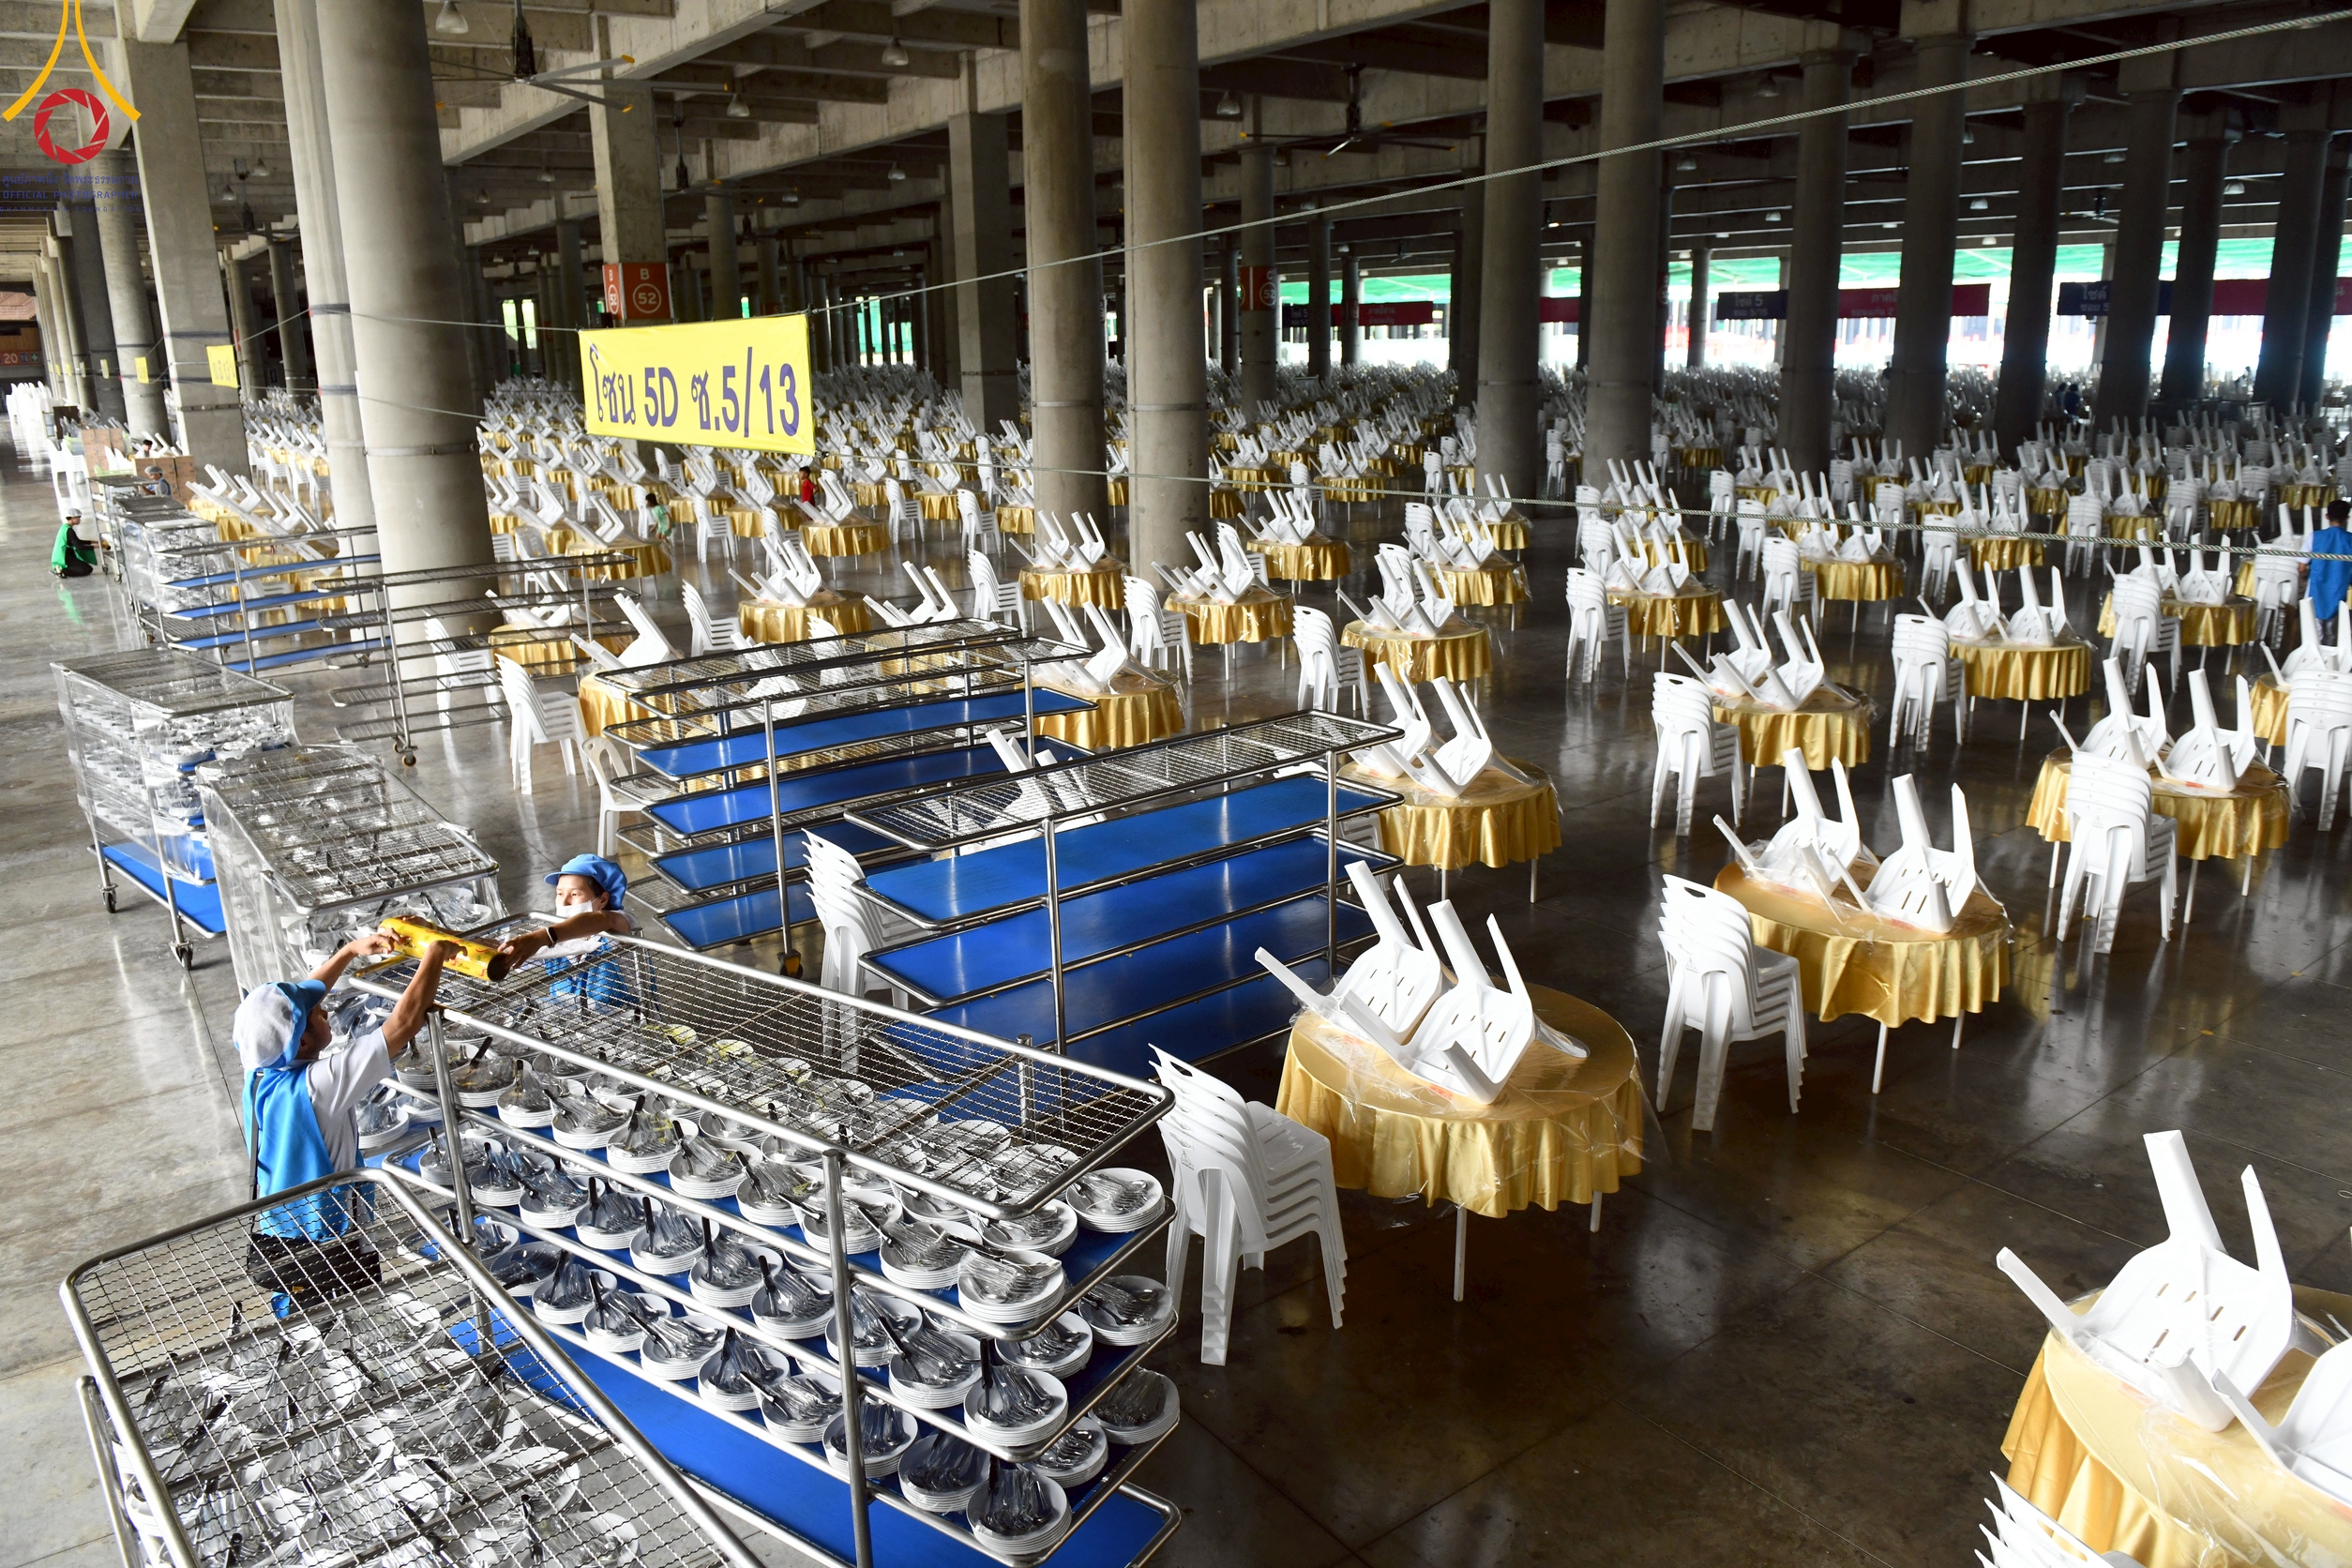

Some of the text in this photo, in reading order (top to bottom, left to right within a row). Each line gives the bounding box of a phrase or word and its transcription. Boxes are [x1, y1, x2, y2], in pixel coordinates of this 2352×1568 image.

[640, 268, 650, 280] B
[638, 293, 656, 305] 52
[1263, 290, 1275, 299] 52
[1755, 294, 1764, 307] 5
[3, 353, 19, 365] 20
[589, 343, 800, 438] โซน 5D ซ.5/13
